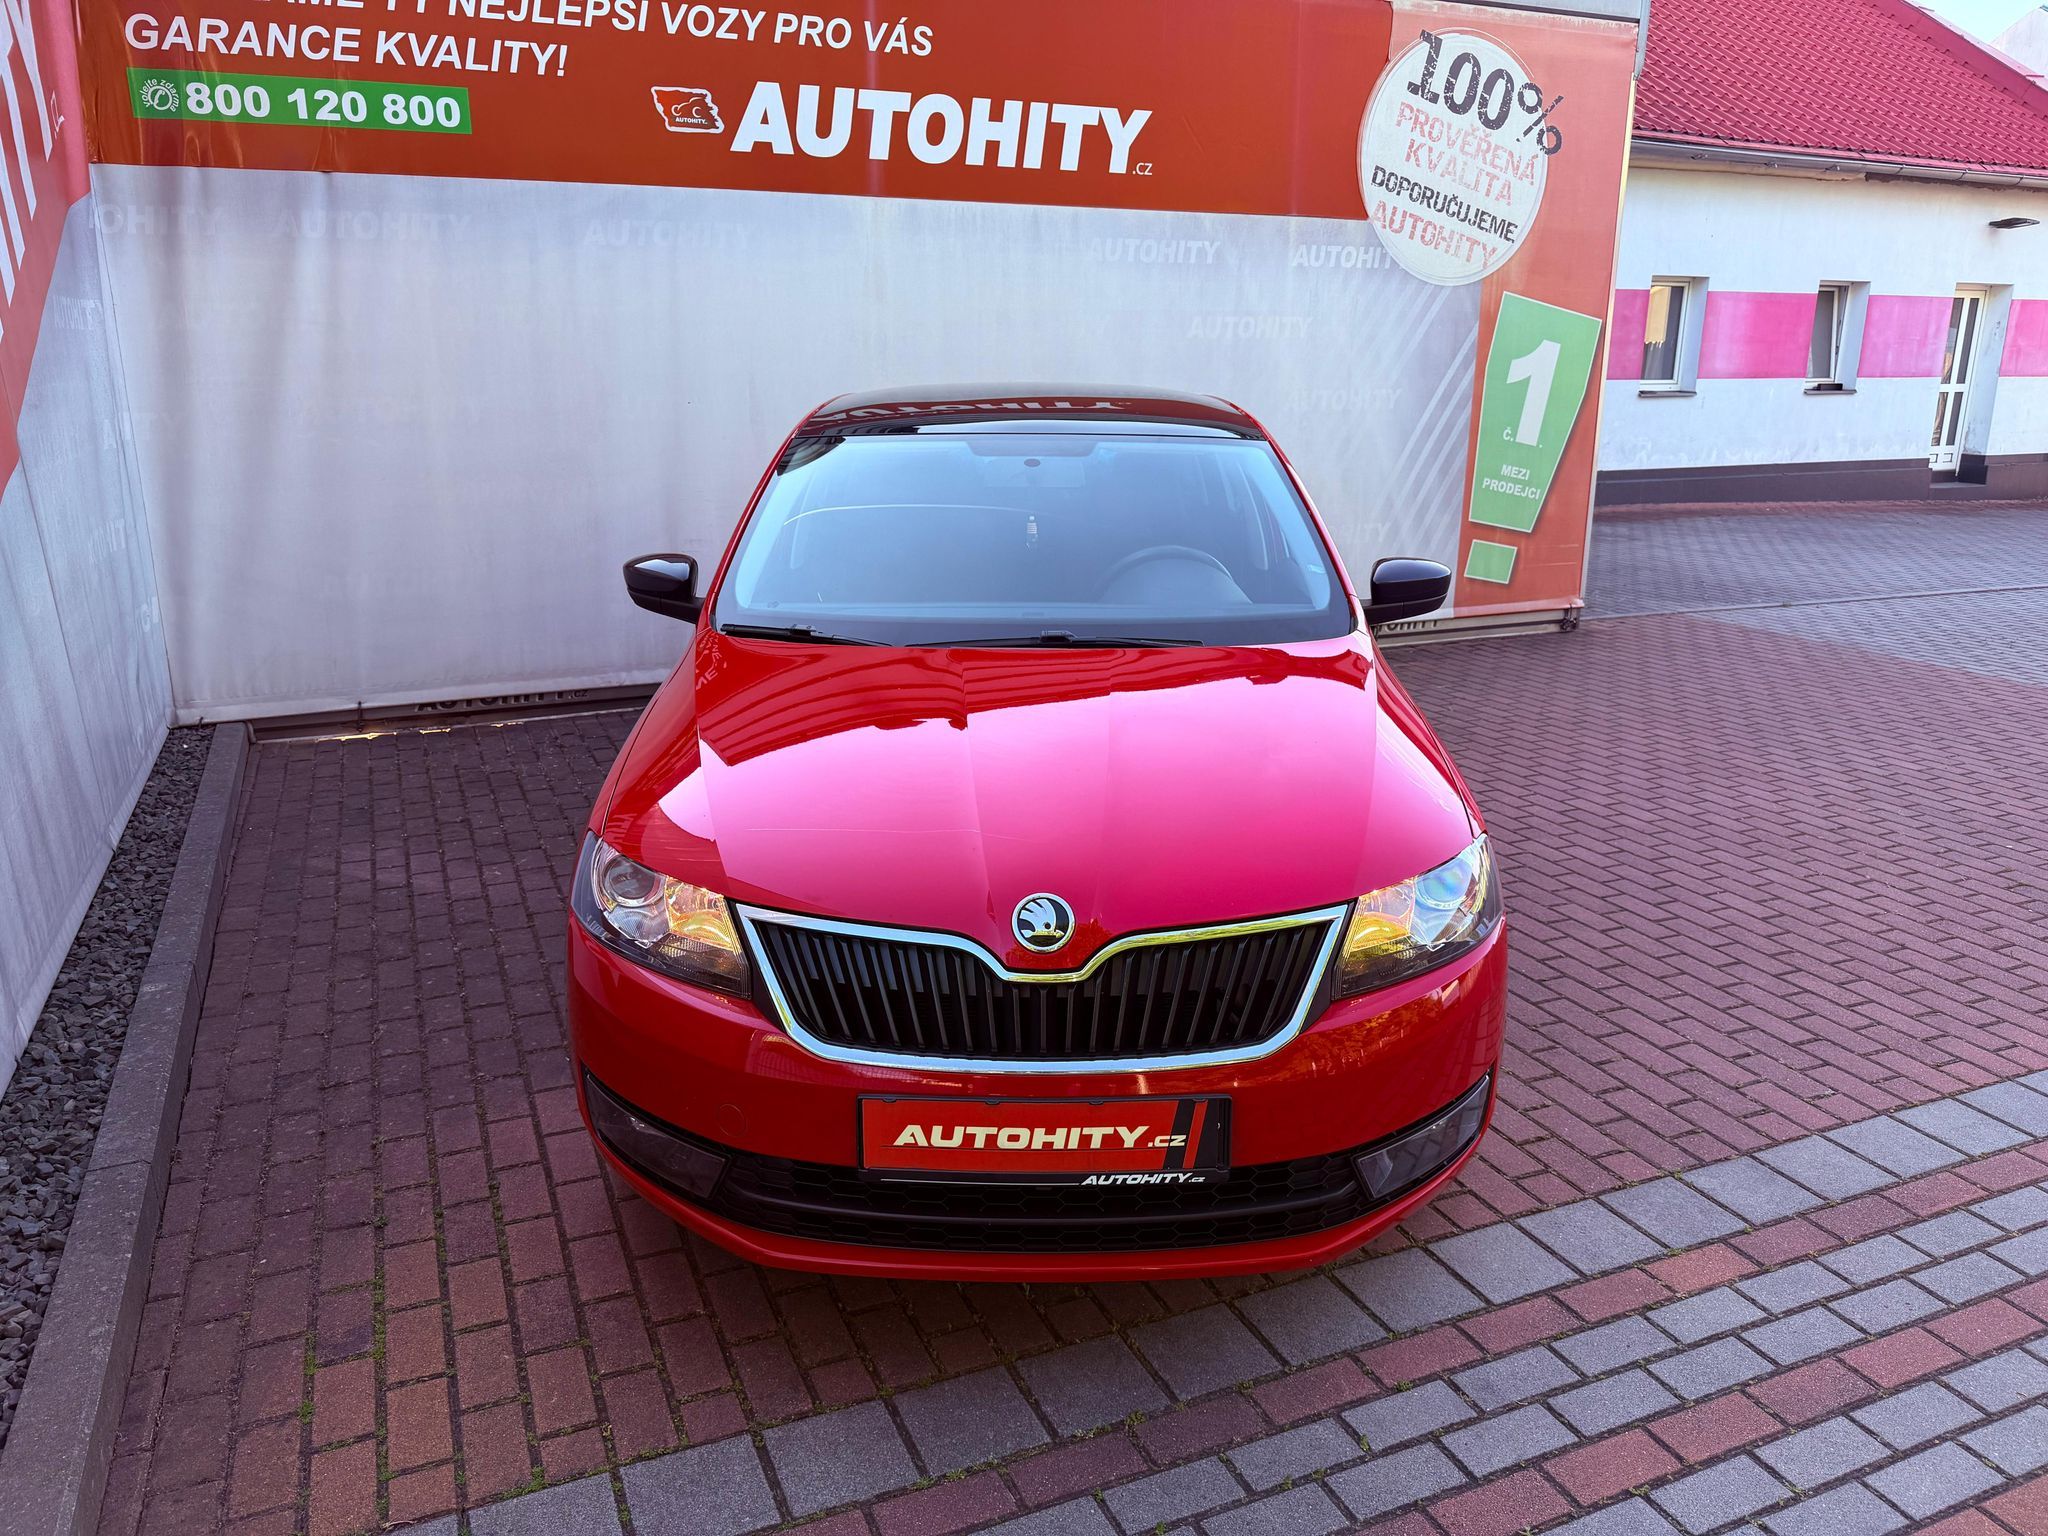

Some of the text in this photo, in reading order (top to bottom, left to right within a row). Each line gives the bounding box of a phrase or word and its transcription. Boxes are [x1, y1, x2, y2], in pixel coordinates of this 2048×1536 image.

[124, 13, 568, 78] GARANCE KVALITY!
[661, 2, 766, 42] VOZY
[773, 11, 853, 49] PRO
[864, 16, 934, 56] VÁS
[185, 82, 462, 129] 800 120 800
[1406, 29, 1565, 156] 100%
[1395, 101, 1539, 187] PROVĚŘENÁ
[1405, 138, 1513, 207] KVALITA
[1371, 164, 1519, 244] DOPORUČUJEME
[1371, 199, 1498, 270] AUTOHITY
[1482, 477, 1541, 500] PRODEJCI
[1501, 464, 1531, 481] MEZI
